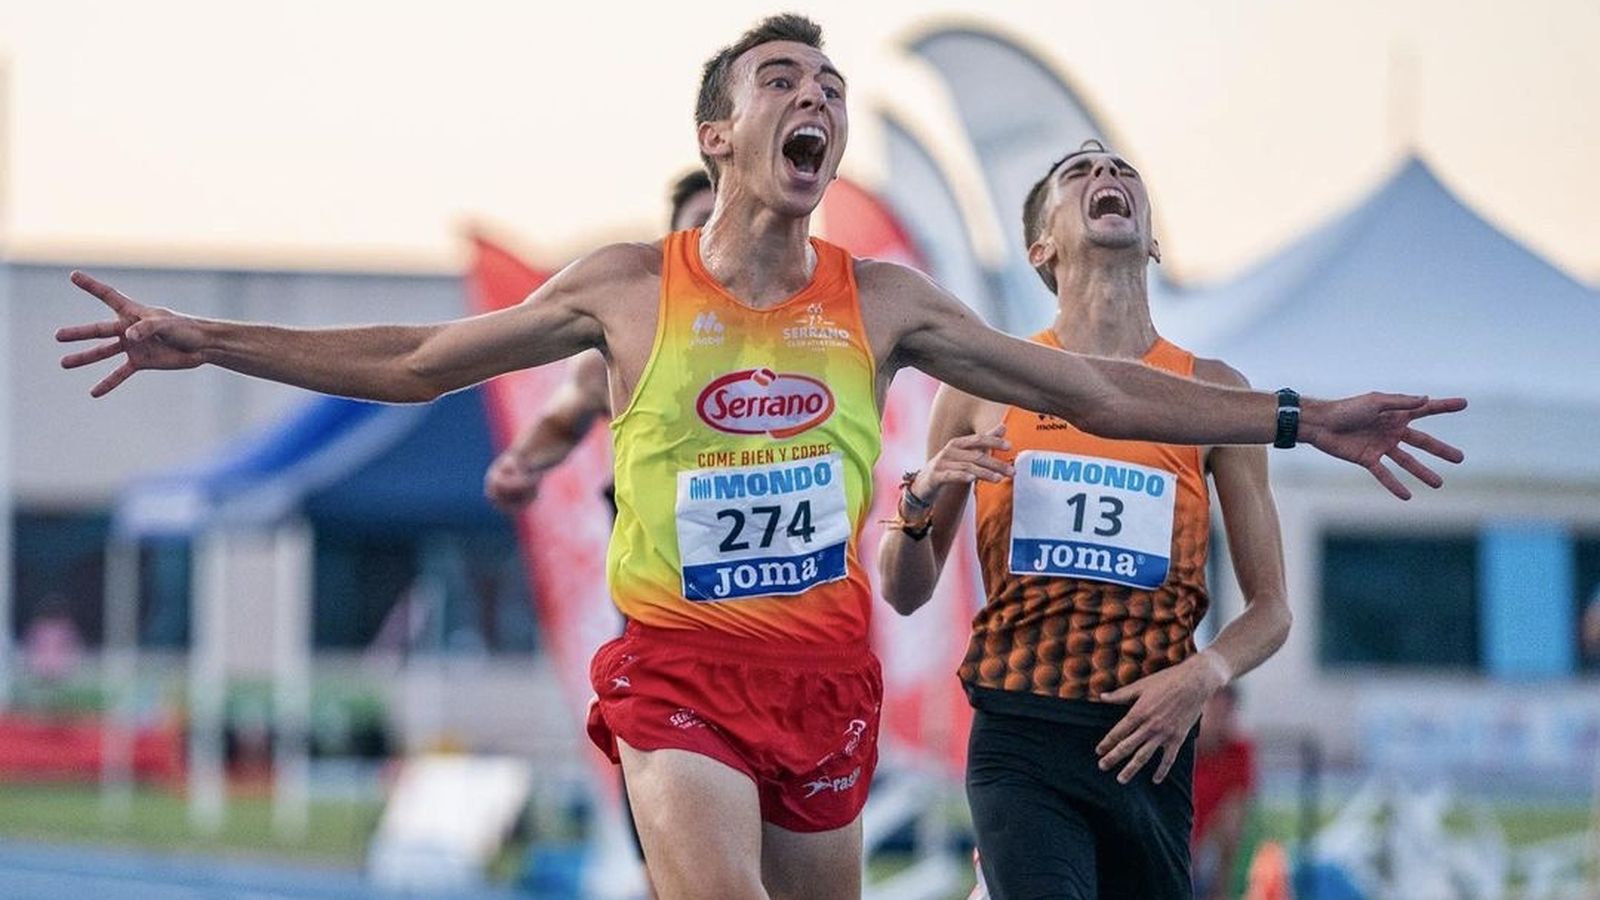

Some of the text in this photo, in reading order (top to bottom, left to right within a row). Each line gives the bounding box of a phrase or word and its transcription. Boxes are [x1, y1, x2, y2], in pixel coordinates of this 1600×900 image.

[783, 326, 849, 340] SERRANO
[711, 389, 823, 419] Serrano
[698, 452, 735, 467] COME
[741, 449, 774, 464] BIEN
[778, 448, 787, 462] Y
[714, 462, 832, 499] MONDO
[1052, 459, 1164, 497] MONDO
[717, 500, 815, 552] 274
[1066, 493, 1124, 537] 13
